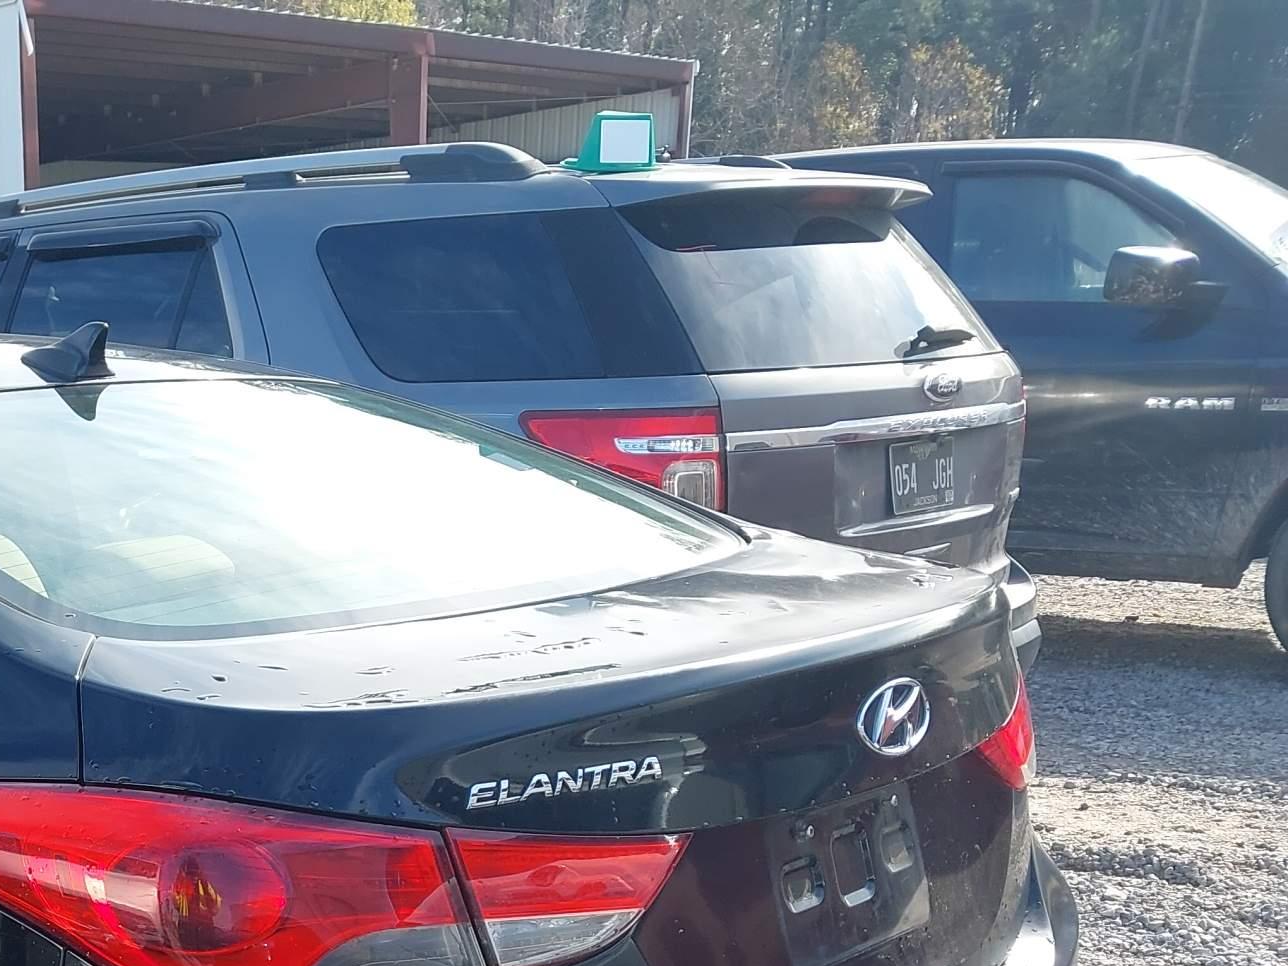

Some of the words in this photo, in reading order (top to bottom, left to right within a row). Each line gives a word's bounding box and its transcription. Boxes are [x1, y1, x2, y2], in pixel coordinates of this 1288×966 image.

[1144, 396, 1235, 410] RAM
[894, 463, 918, 497] 054
[932, 455, 954, 490] JGH
[466, 756, 663, 810] ELANTRA
